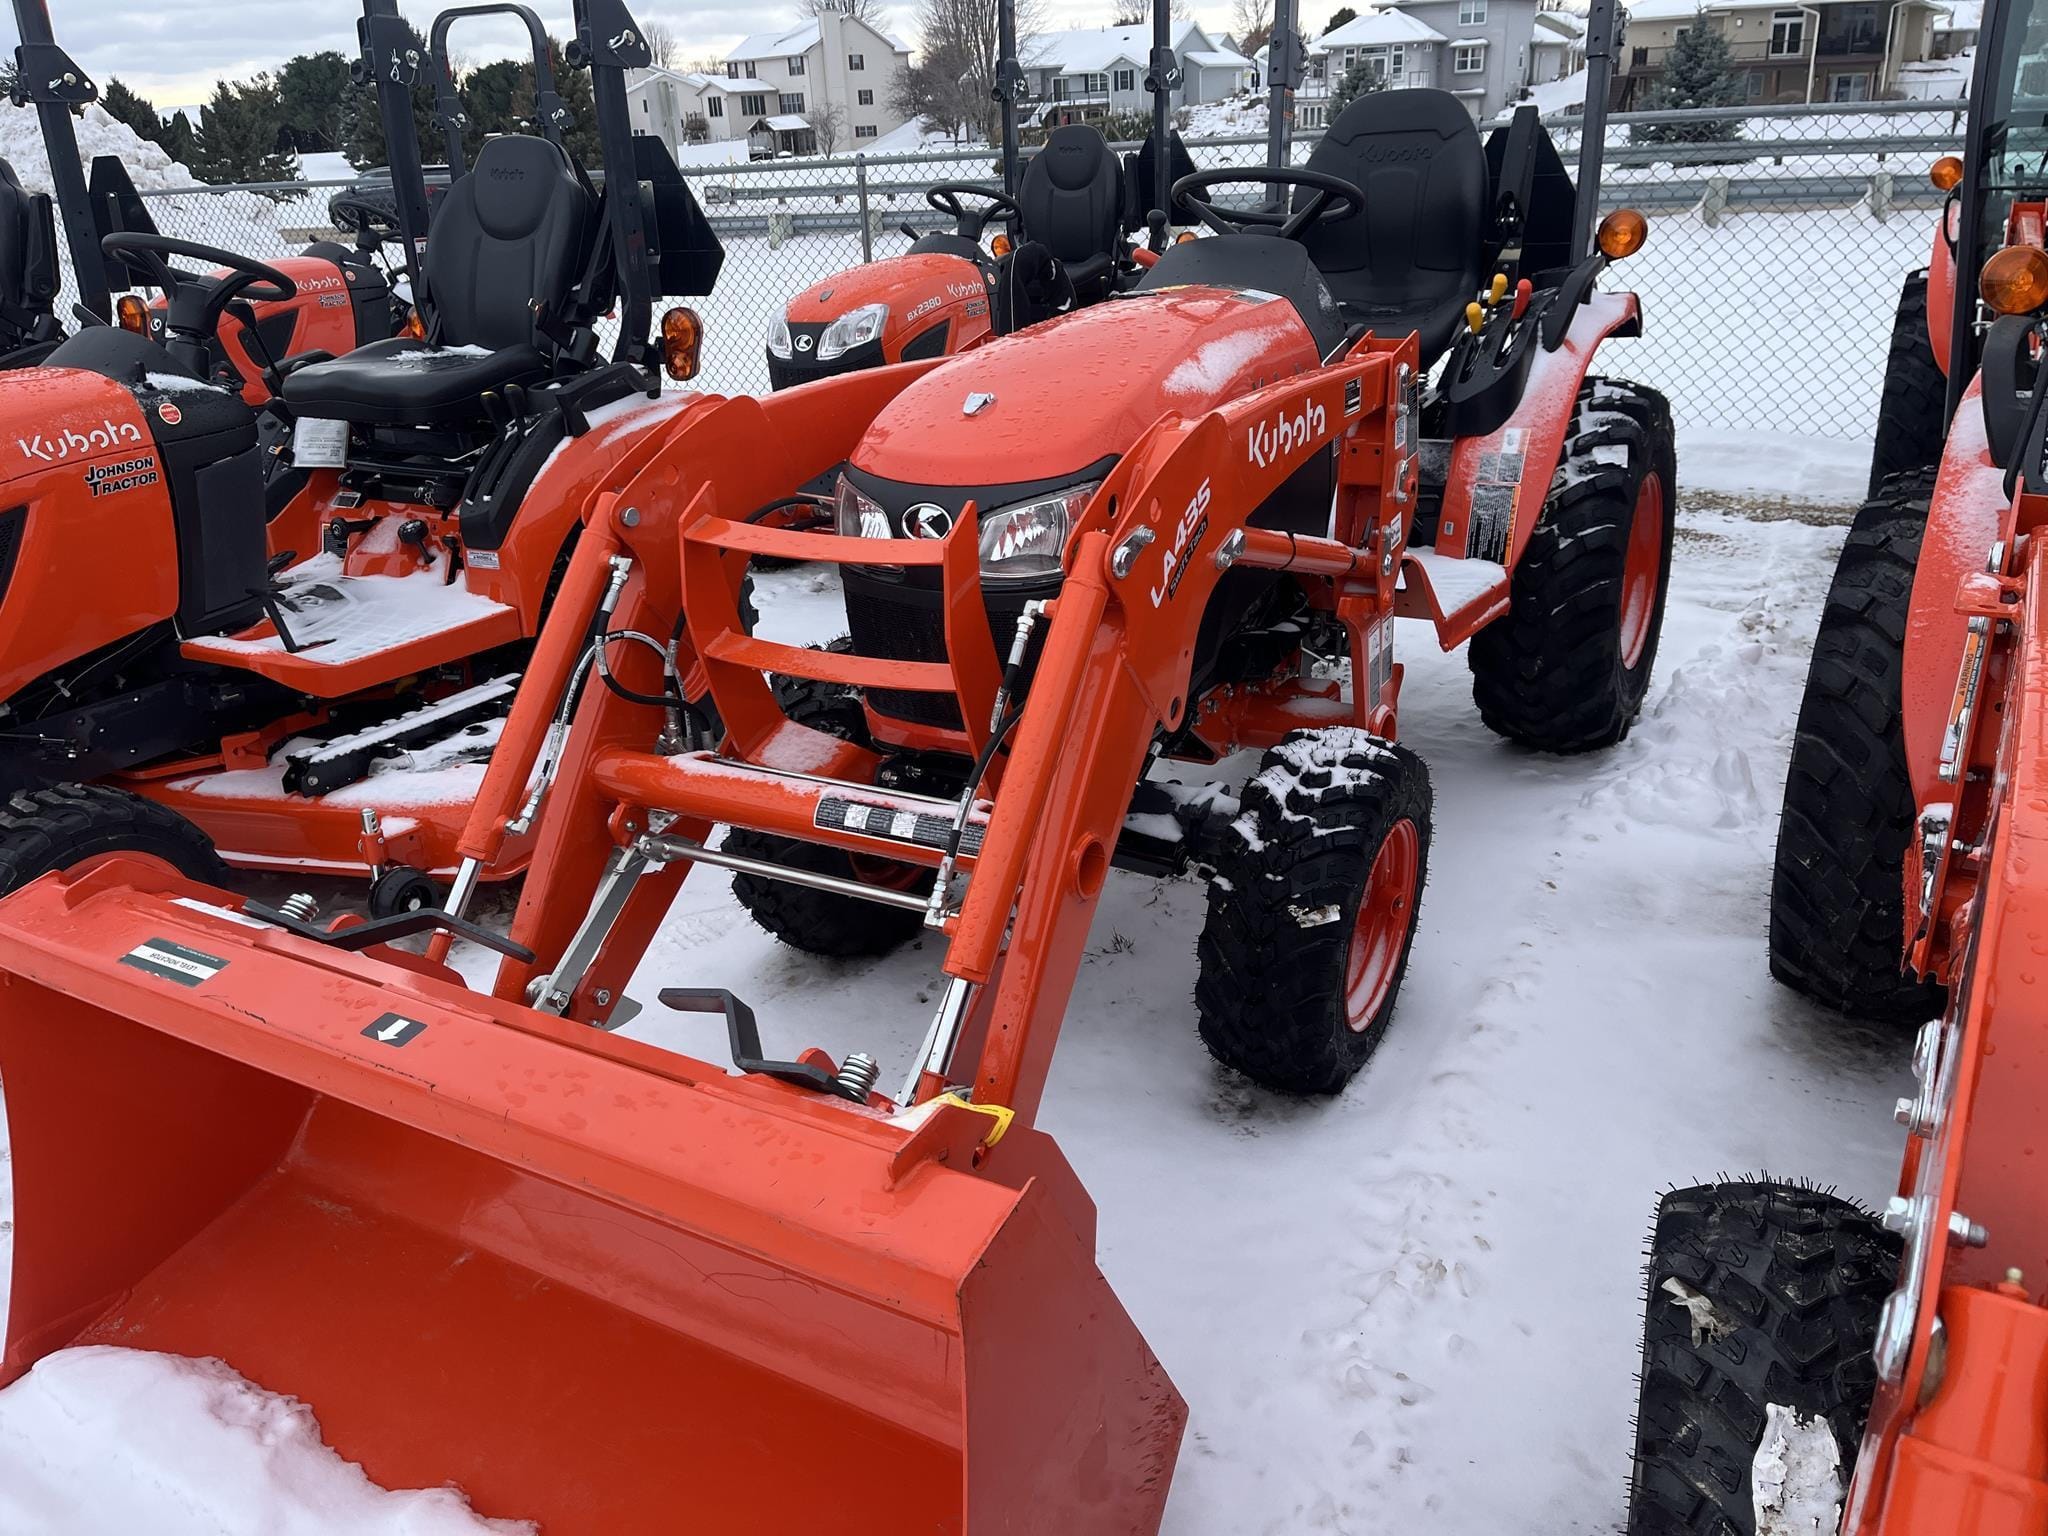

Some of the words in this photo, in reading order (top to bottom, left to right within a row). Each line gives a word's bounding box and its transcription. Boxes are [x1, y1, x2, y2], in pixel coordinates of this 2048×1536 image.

[946, 280, 985, 297] Kubota
[906, 296, 942, 321] BX2380
[18, 419, 142, 462] Kubota
[1248, 397, 1326, 469] Kubota
[85, 456, 155, 482] JOHNSON
[88, 472, 158, 497] TRACTOR
[1150, 476, 1211, 609] LA435
[1960, 653, 1974, 689] WARNING
[149, 952, 179, 966] INDICATOR
[179, 961, 198, 972] LEVEL
